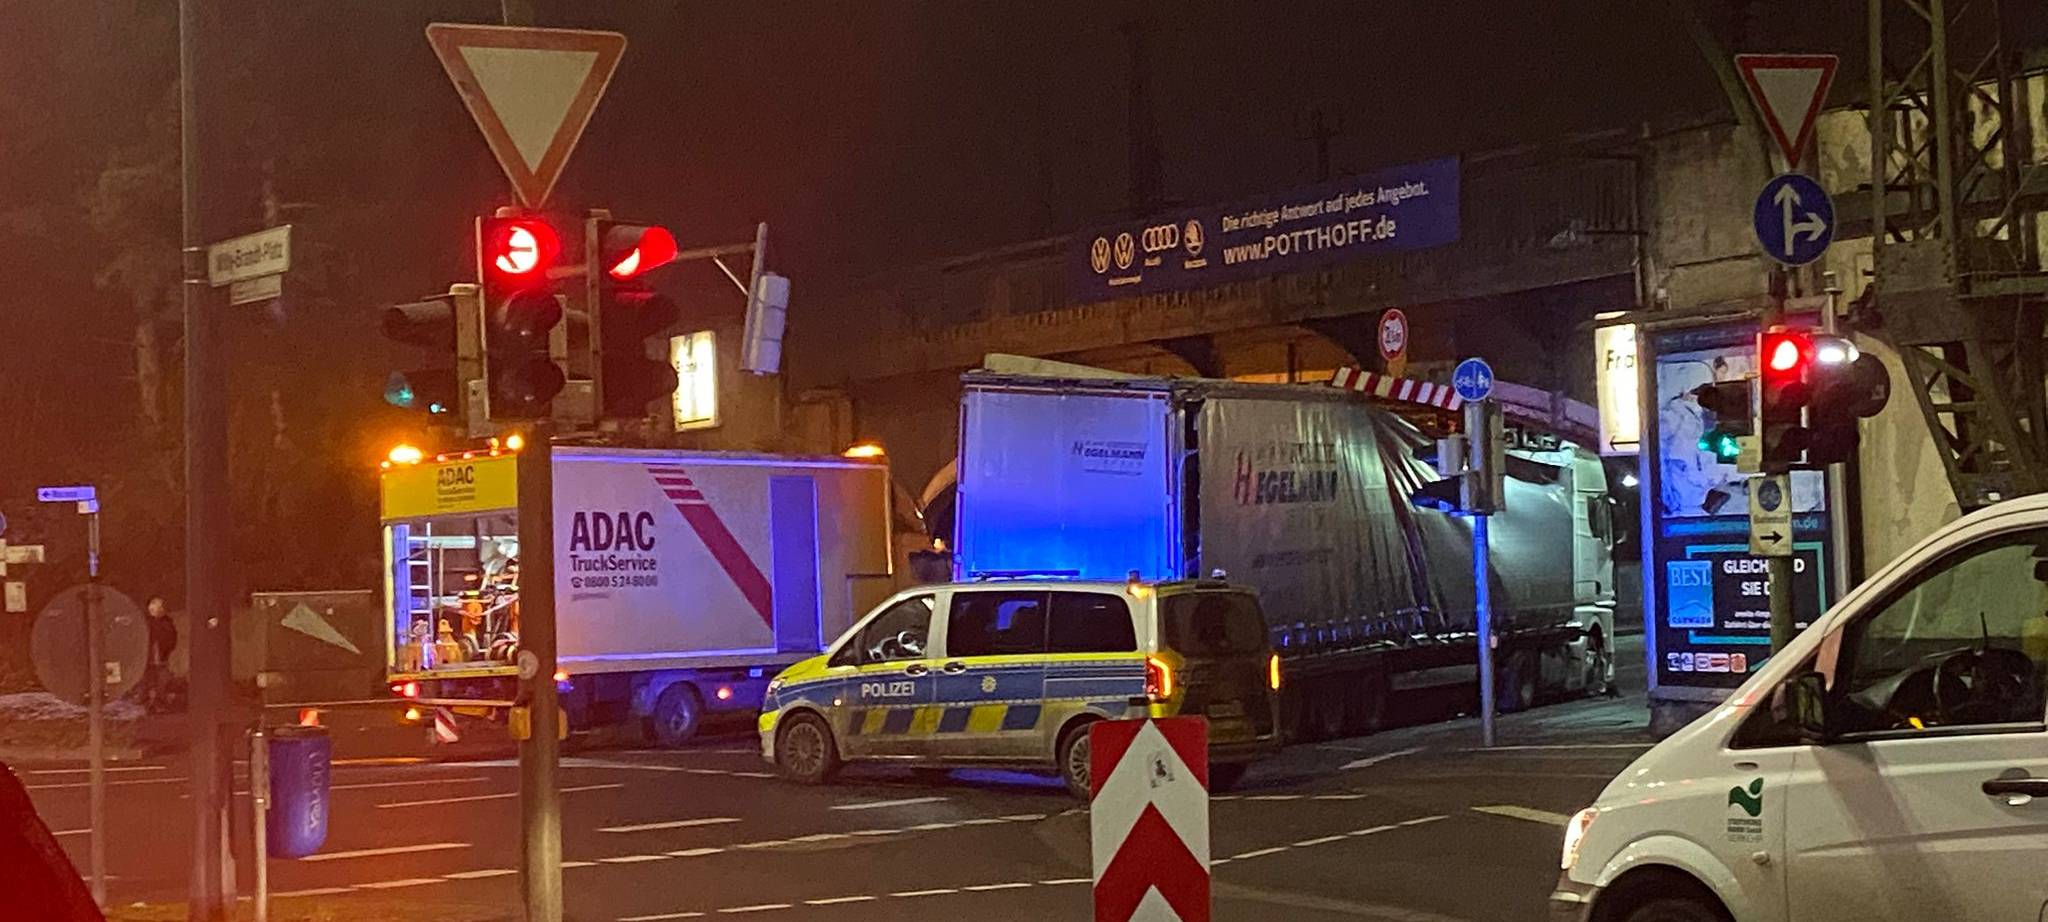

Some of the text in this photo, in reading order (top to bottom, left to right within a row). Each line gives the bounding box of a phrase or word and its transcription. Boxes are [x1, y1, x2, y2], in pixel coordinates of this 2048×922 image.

[1222, 181, 1429, 232] Die richtige Antwort auf jedes Angebot.
[1223, 215, 1396, 265] www.POTTHOFF.de
[437, 465, 474, 487] ADAC
[569, 510, 656, 552] ADAC
[569, 553, 657, 572] TruckService
[1723, 559, 1770, 574] GLEICH
[1671, 567, 1712, 586] BEST
[1741, 581, 1762, 596] SIE
[861, 681, 915, 699] POLIZEI
